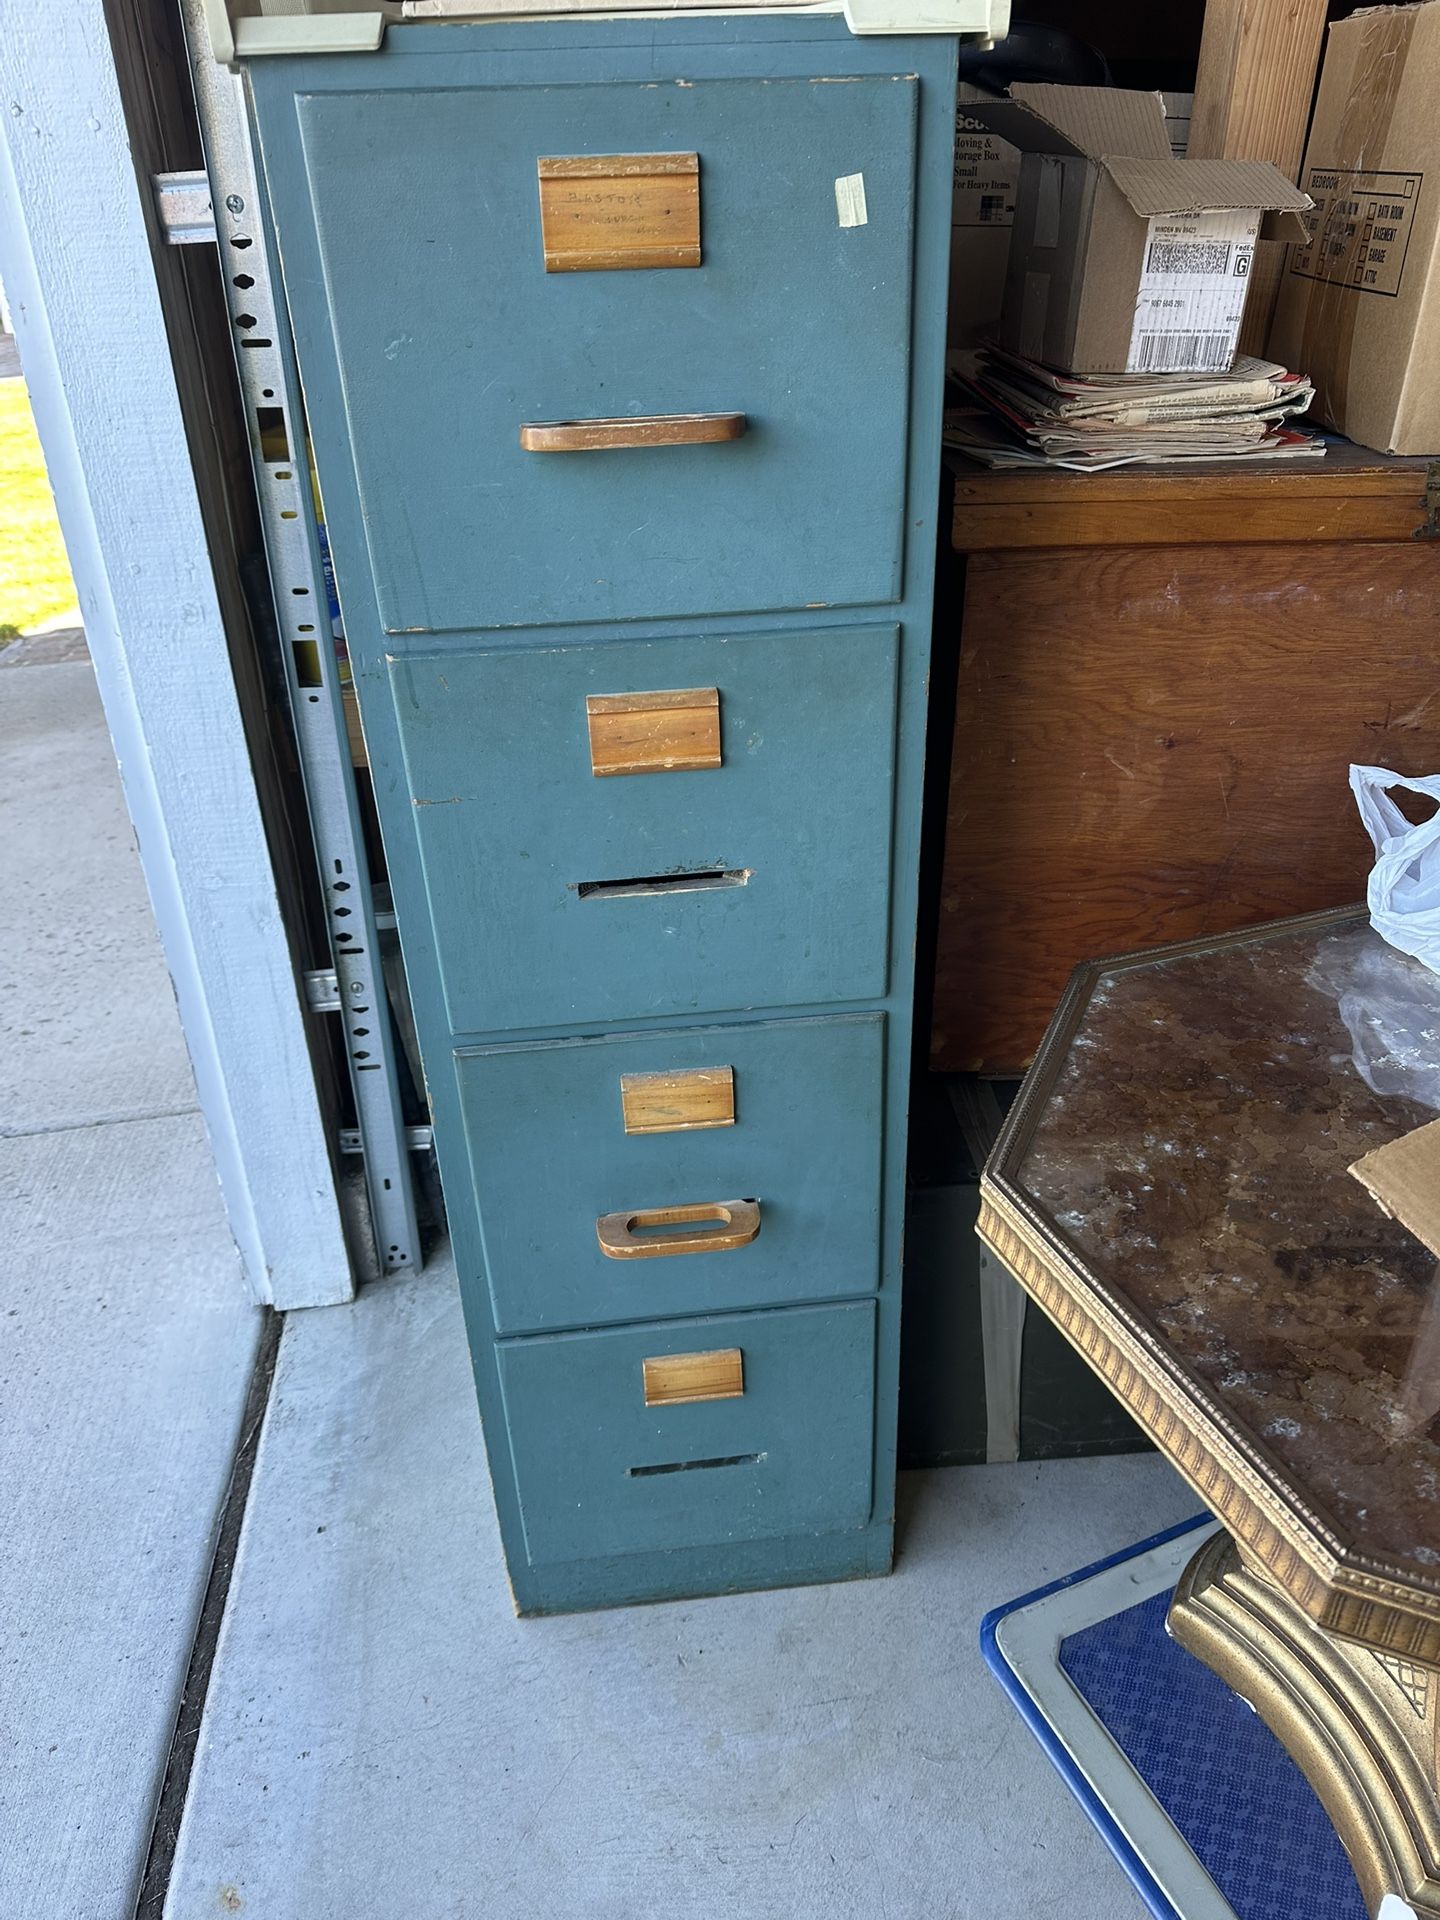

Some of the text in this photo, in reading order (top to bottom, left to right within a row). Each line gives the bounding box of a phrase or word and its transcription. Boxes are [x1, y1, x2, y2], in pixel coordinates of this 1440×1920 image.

[956, 114, 990, 130] Sco
[984, 137, 993, 148] &
[954, 151, 1000, 163] torage Box
[954, 166, 978, 177] Small
[967, 180, 990, 191] Heavy
[991, 180, 1011, 189] Items
[1373, 226, 1398, 242] BASEMENT
[1235, 244, 1254, 252] FedEx
[1368, 248, 1387, 263] GARAGE
[1237, 257, 1248, 274] G
[1364, 269, 1378, 284] ATTIC
